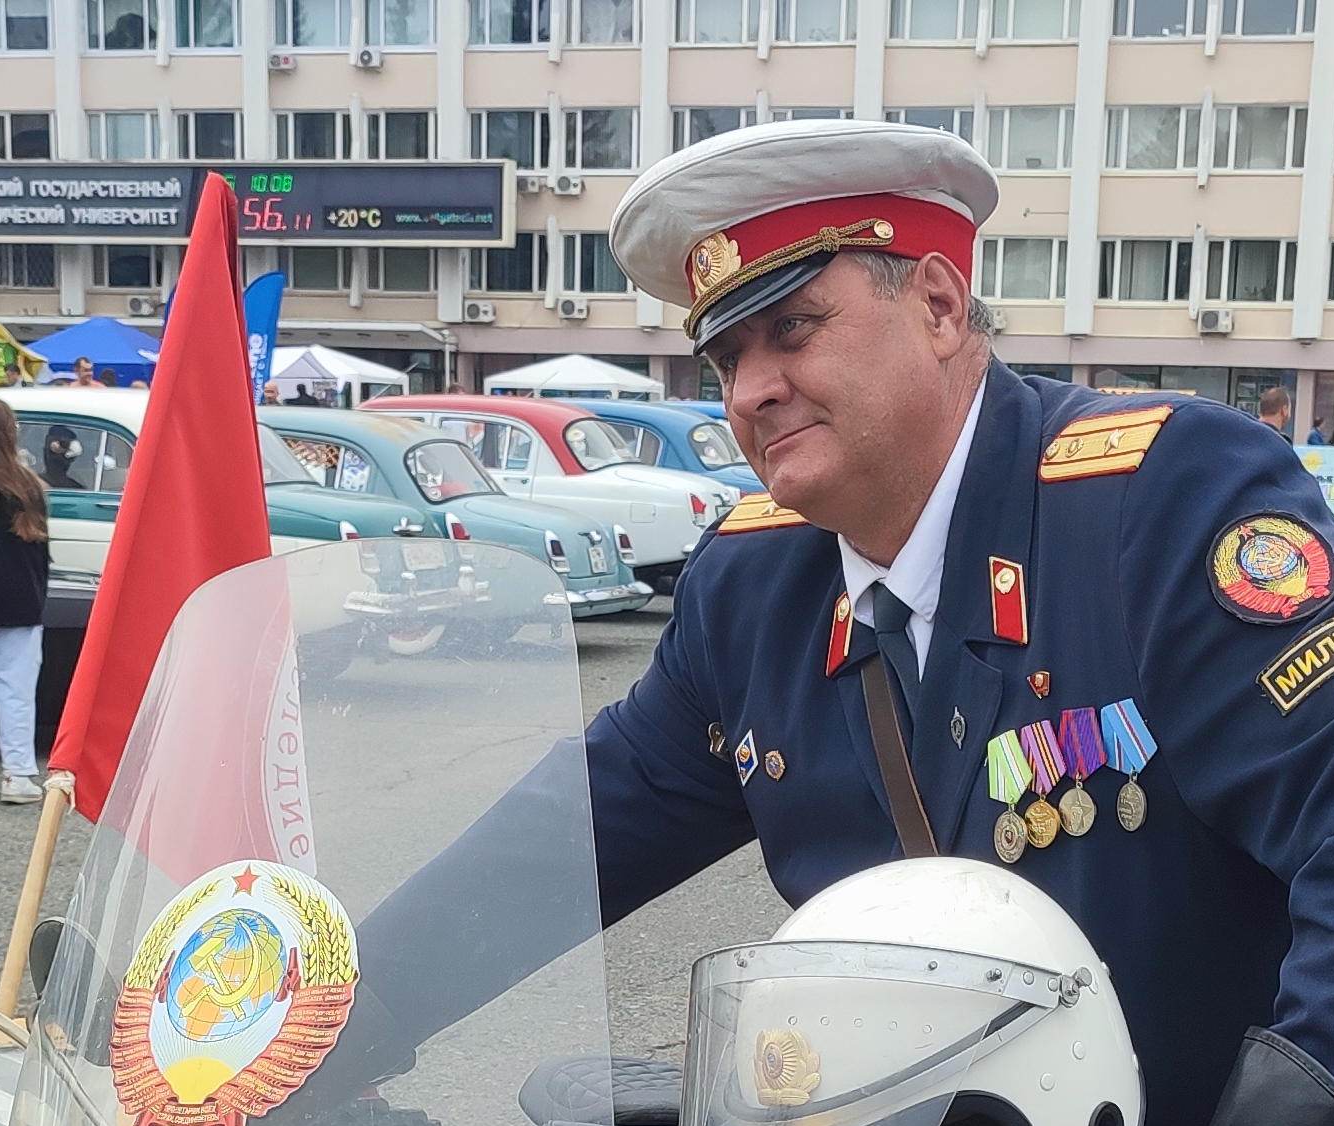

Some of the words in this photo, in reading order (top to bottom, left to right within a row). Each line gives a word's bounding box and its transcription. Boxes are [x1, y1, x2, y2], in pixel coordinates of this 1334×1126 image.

[29, 178, 182, 199] ГОСУДАРСТВЕННЫЙ
[71, 207, 178, 226] УНИВЕРСИТЕТ
[326, 208, 382, 228] +20°C
